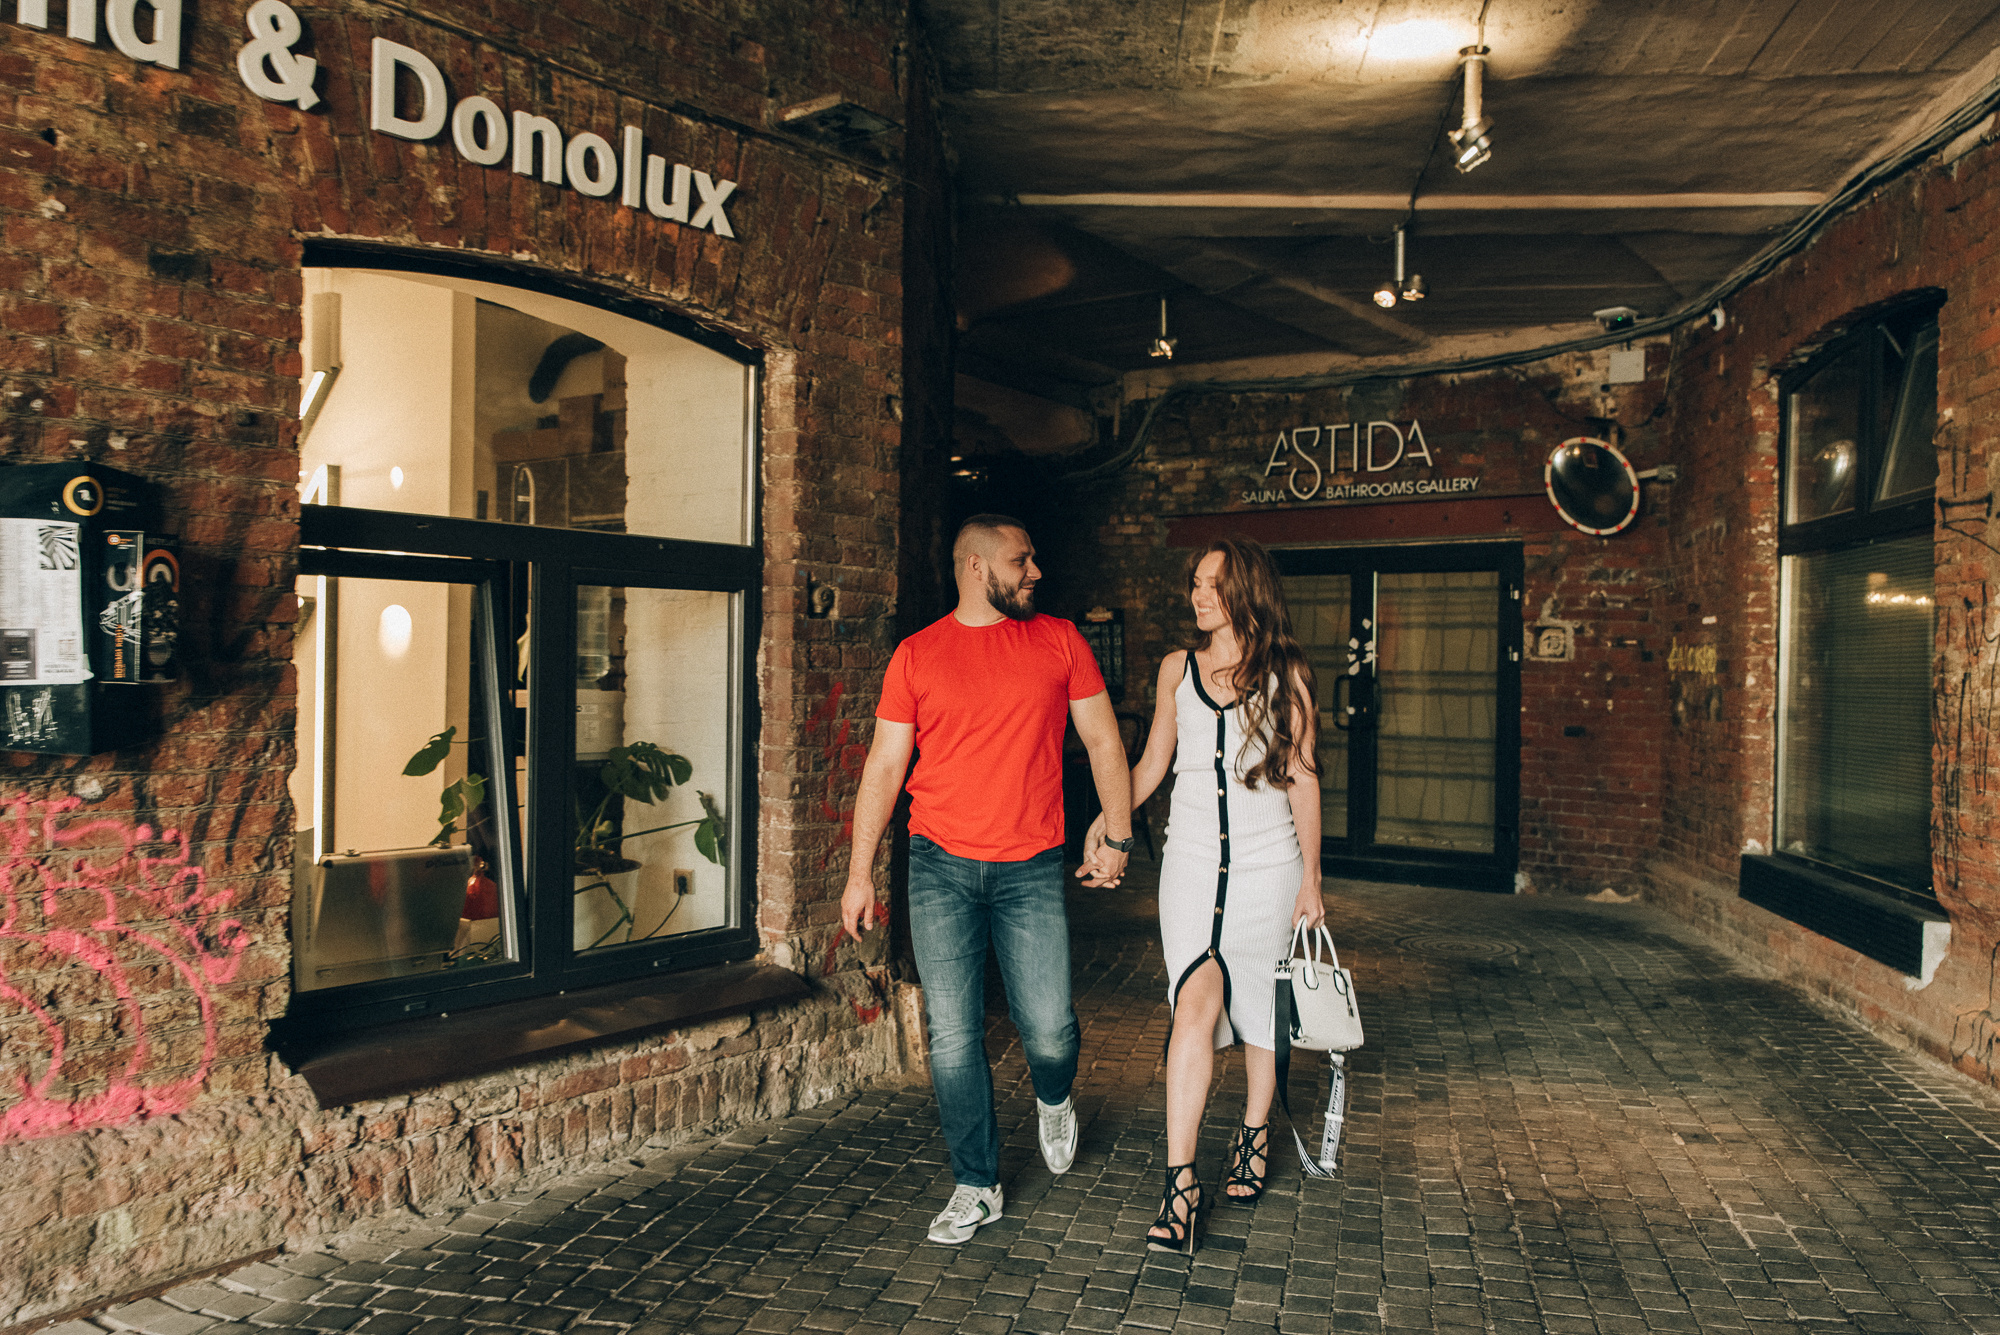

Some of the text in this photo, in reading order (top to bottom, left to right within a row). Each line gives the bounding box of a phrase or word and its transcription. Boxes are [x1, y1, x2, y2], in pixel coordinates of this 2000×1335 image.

[237, 0, 320, 111] &
[370, 36, 737, 239] Donolux
[1241, 476, 1480, 504] SAUNA BATHROOMS GALLERY
[1264, 418, 1433, 500] ASTIDA
